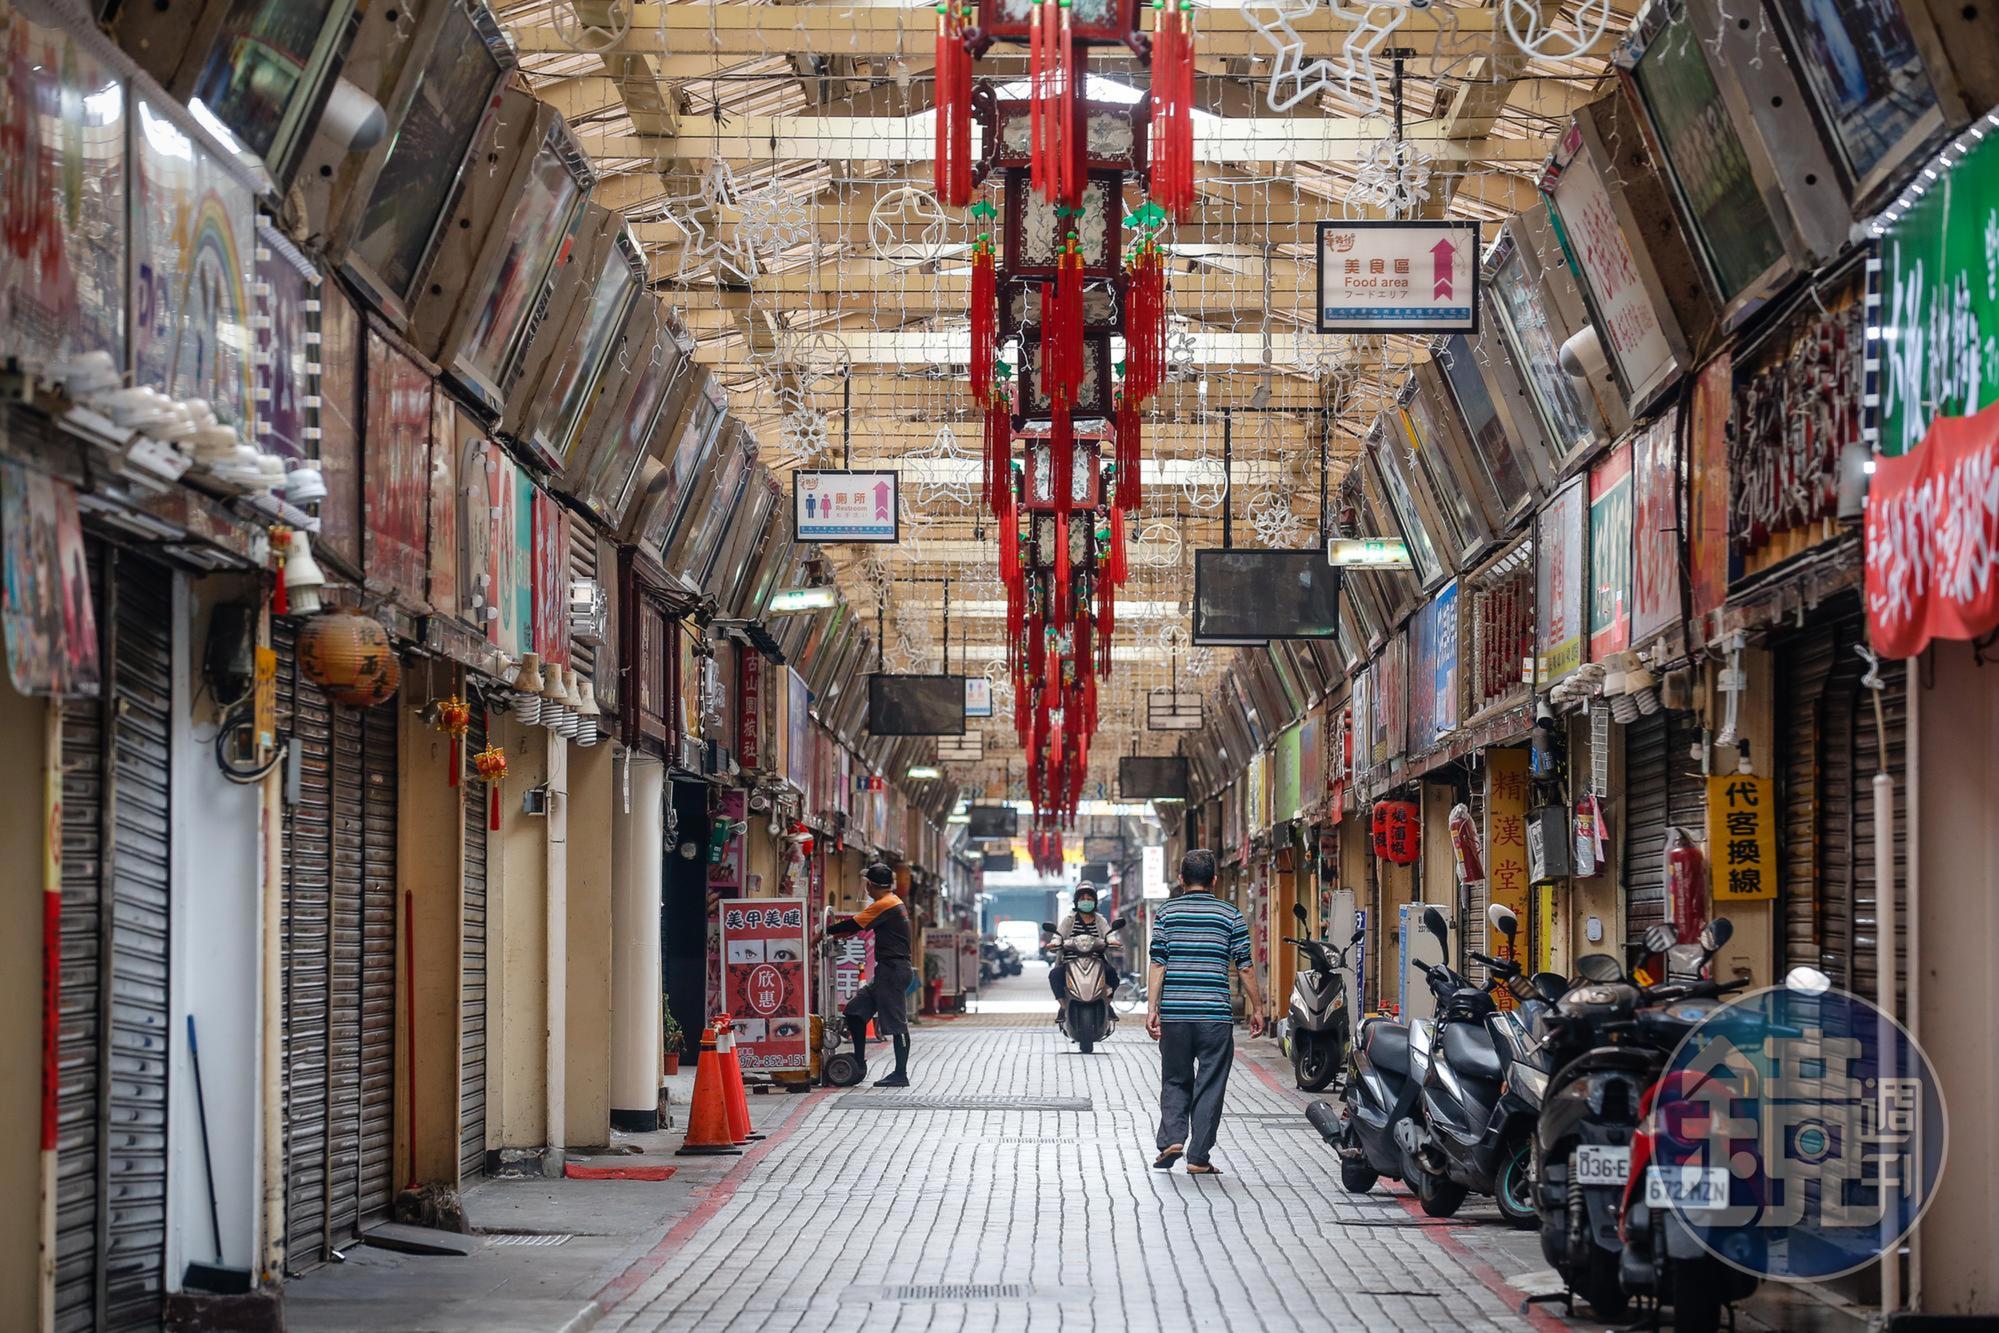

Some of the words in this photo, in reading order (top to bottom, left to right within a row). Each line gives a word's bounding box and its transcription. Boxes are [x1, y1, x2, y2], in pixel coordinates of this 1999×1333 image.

[1344, 258, 1410, 274] 美食區
[1344, 276, 1377, 288] Food
[1381, 278, 1409, 288] area
[1344, 290, 1409, 299] フードエリア
[835, 492, 866, 504] 廁所
[1725, 781, 1762, 894] 代客換線
[726, 908, 802, 930] 美甲美睫
[836, 936, 866, 1000] 美甲
[757, 970, 776, 1008] 欣惠
[739, 1054, 806, 1067] 972-852-151
